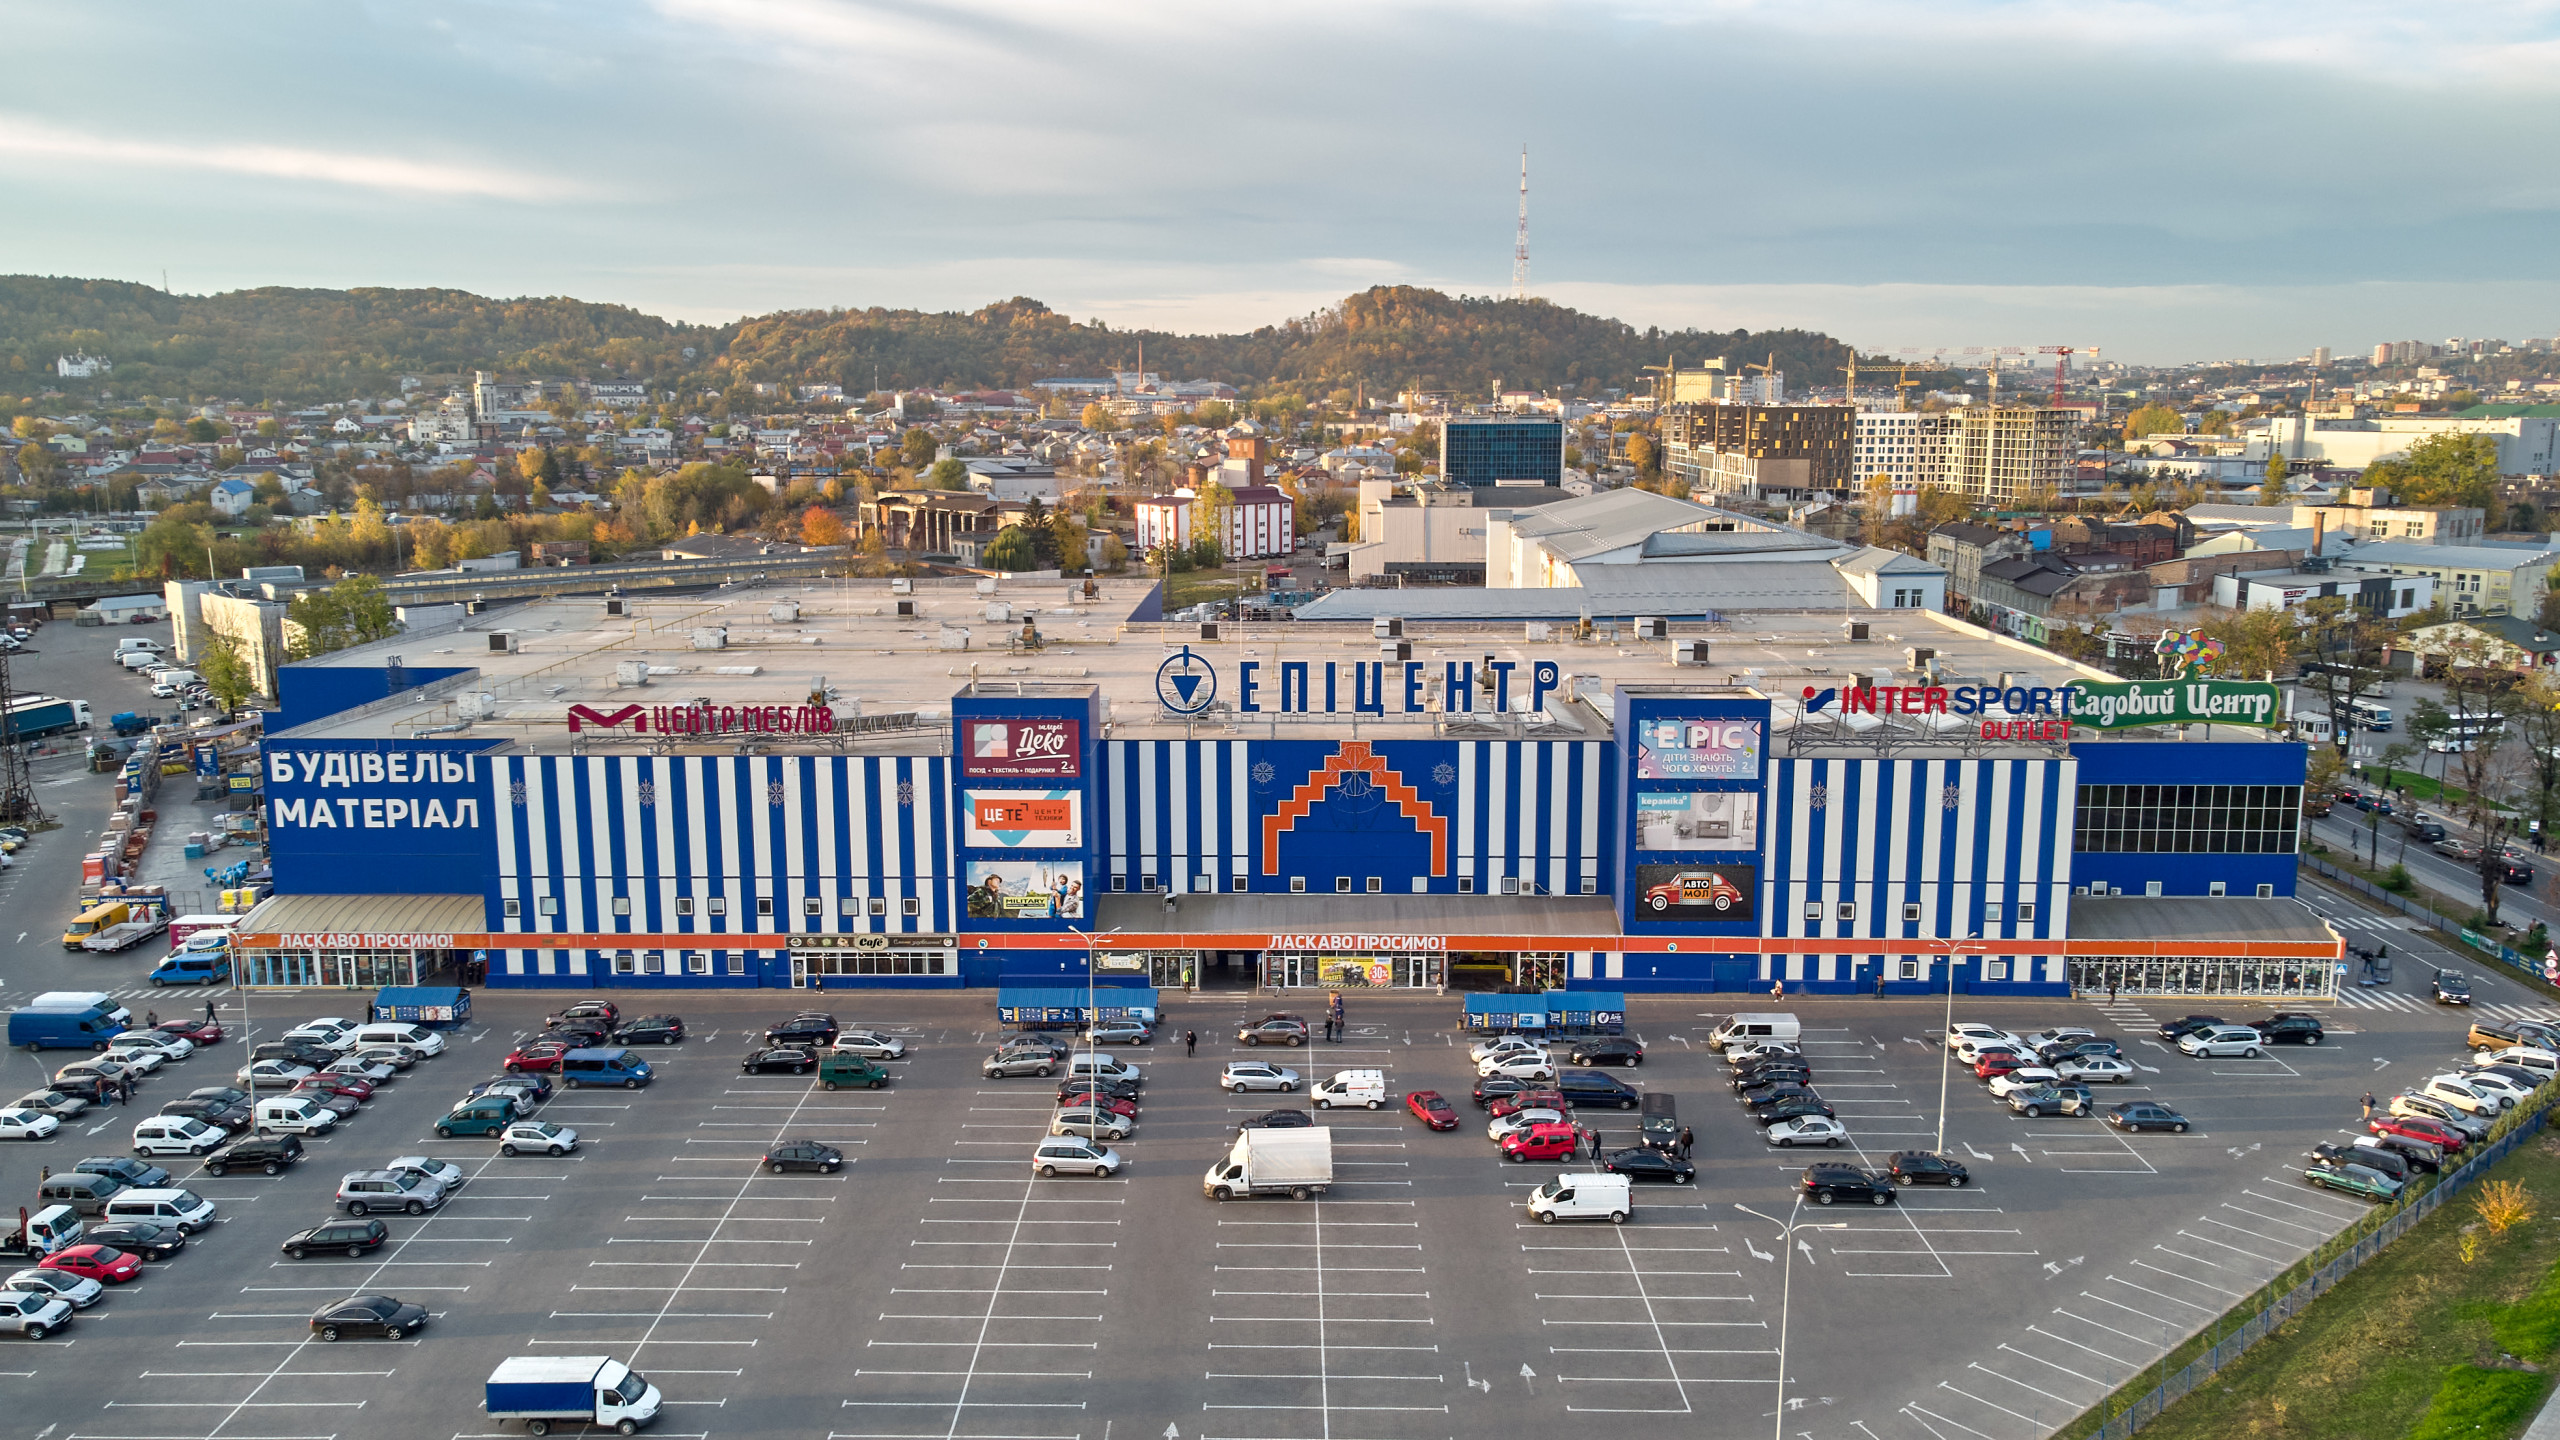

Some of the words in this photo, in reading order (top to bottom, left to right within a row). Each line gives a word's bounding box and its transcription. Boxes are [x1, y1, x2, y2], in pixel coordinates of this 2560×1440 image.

[1239, 660, 1559, 718] ЕПІЦЕНТР
[1841, 685, 2077, 715] INTERSPORT
[2071, 684, 2176, 727] Садовий
[2186, 684, 2271, 723] Центр
[653, 704, 736, 736] ЦЕНТР
[743, 705, 833, 734] МЕБЛІВ
[1980, 720, 2074, 741] OUTLET
[1662, 753, 1687, 763] ДІТИ
[1662, 764, 1690, 773] ЧОГО
[1692, 764, 1736, 773] ХОЧУТЬ!
[275, 798, 479, 828] МАТЕРІАЛ
[1684, 880, 1709, 888] АВТО
[1684, 889, 1709, 898] МОЛ
[279, 934, 359, 948] ЛАСКАВО
[364, 934, 454, 948] ПРОСИМО!
[859, 937, 883, 948] Café
[1270, 934, 1353, 949] ЛАСКАВО
[1357, 934, 1447, 949] ПРОСИМО!
